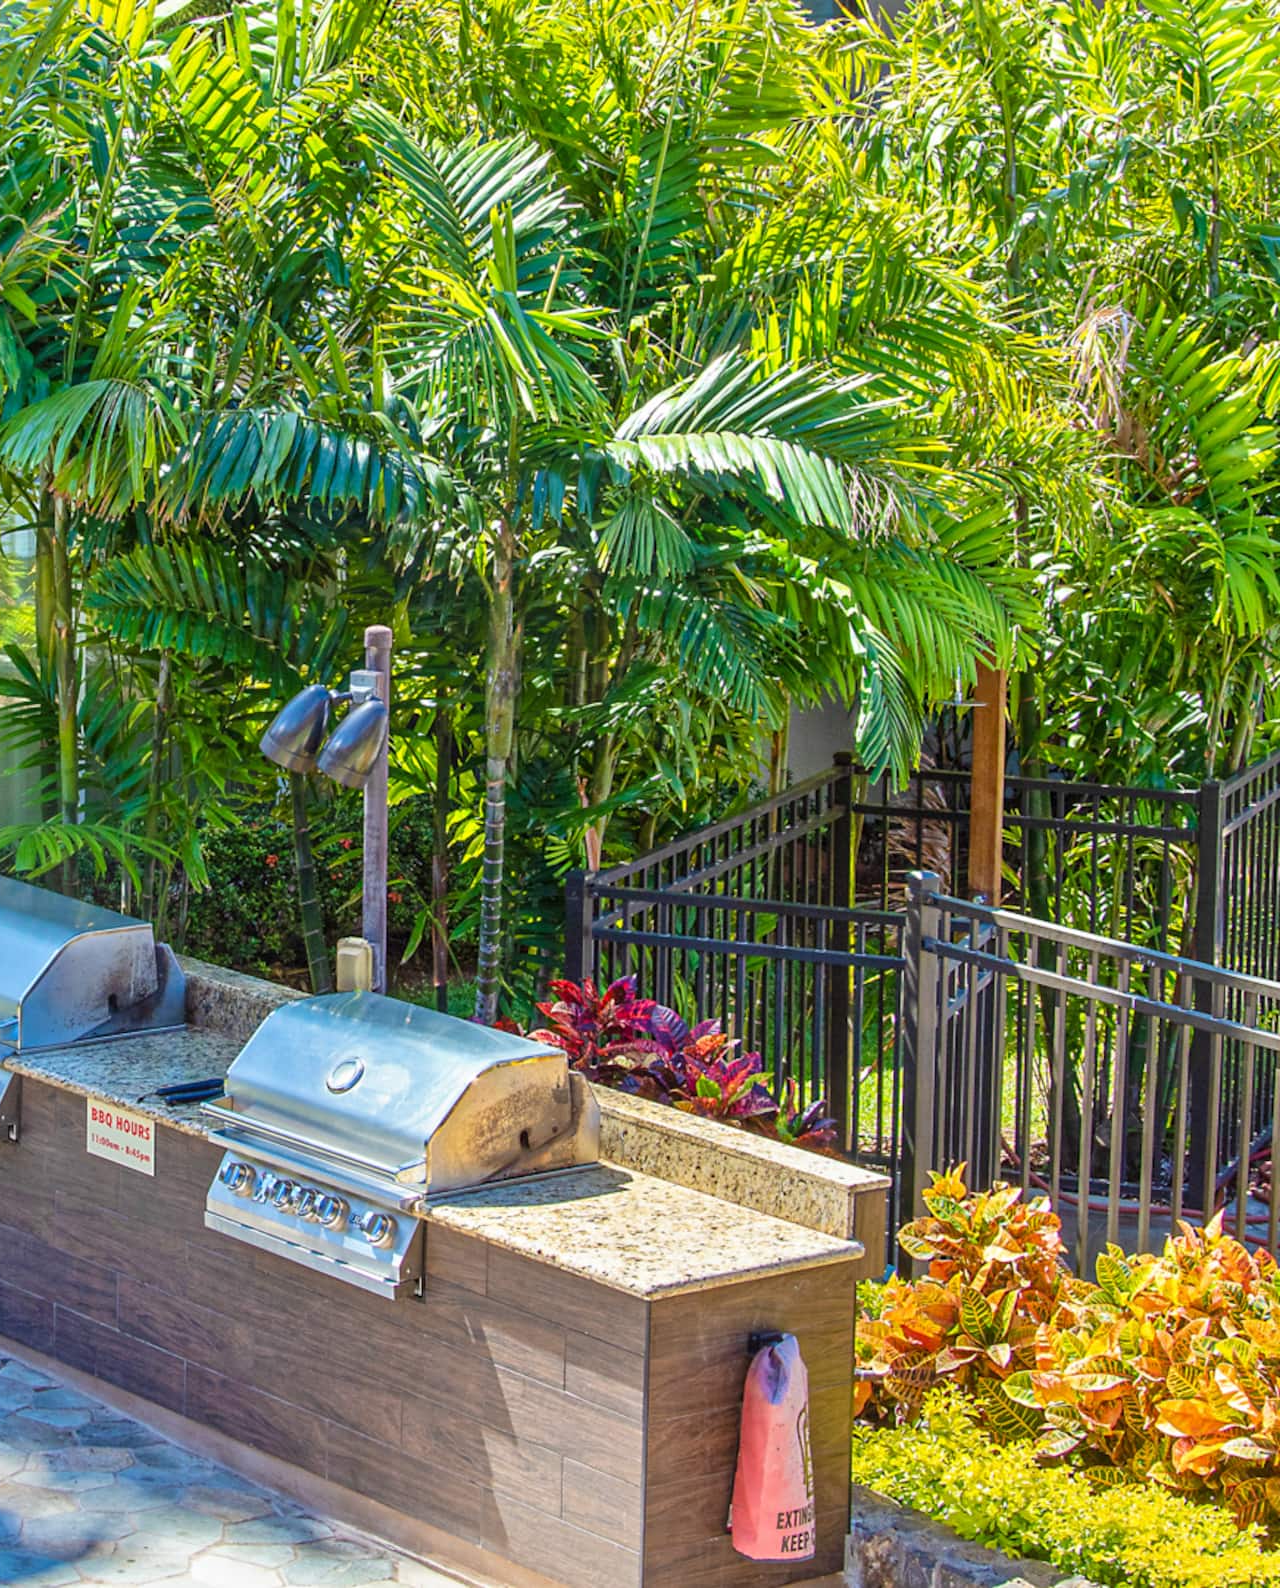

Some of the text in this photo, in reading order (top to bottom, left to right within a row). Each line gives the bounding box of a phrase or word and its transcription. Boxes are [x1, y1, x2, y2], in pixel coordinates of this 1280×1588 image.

[91, 1106, 150, 1141] BBQ HOURS
[781, 1531, 810, 1552] KEEP
